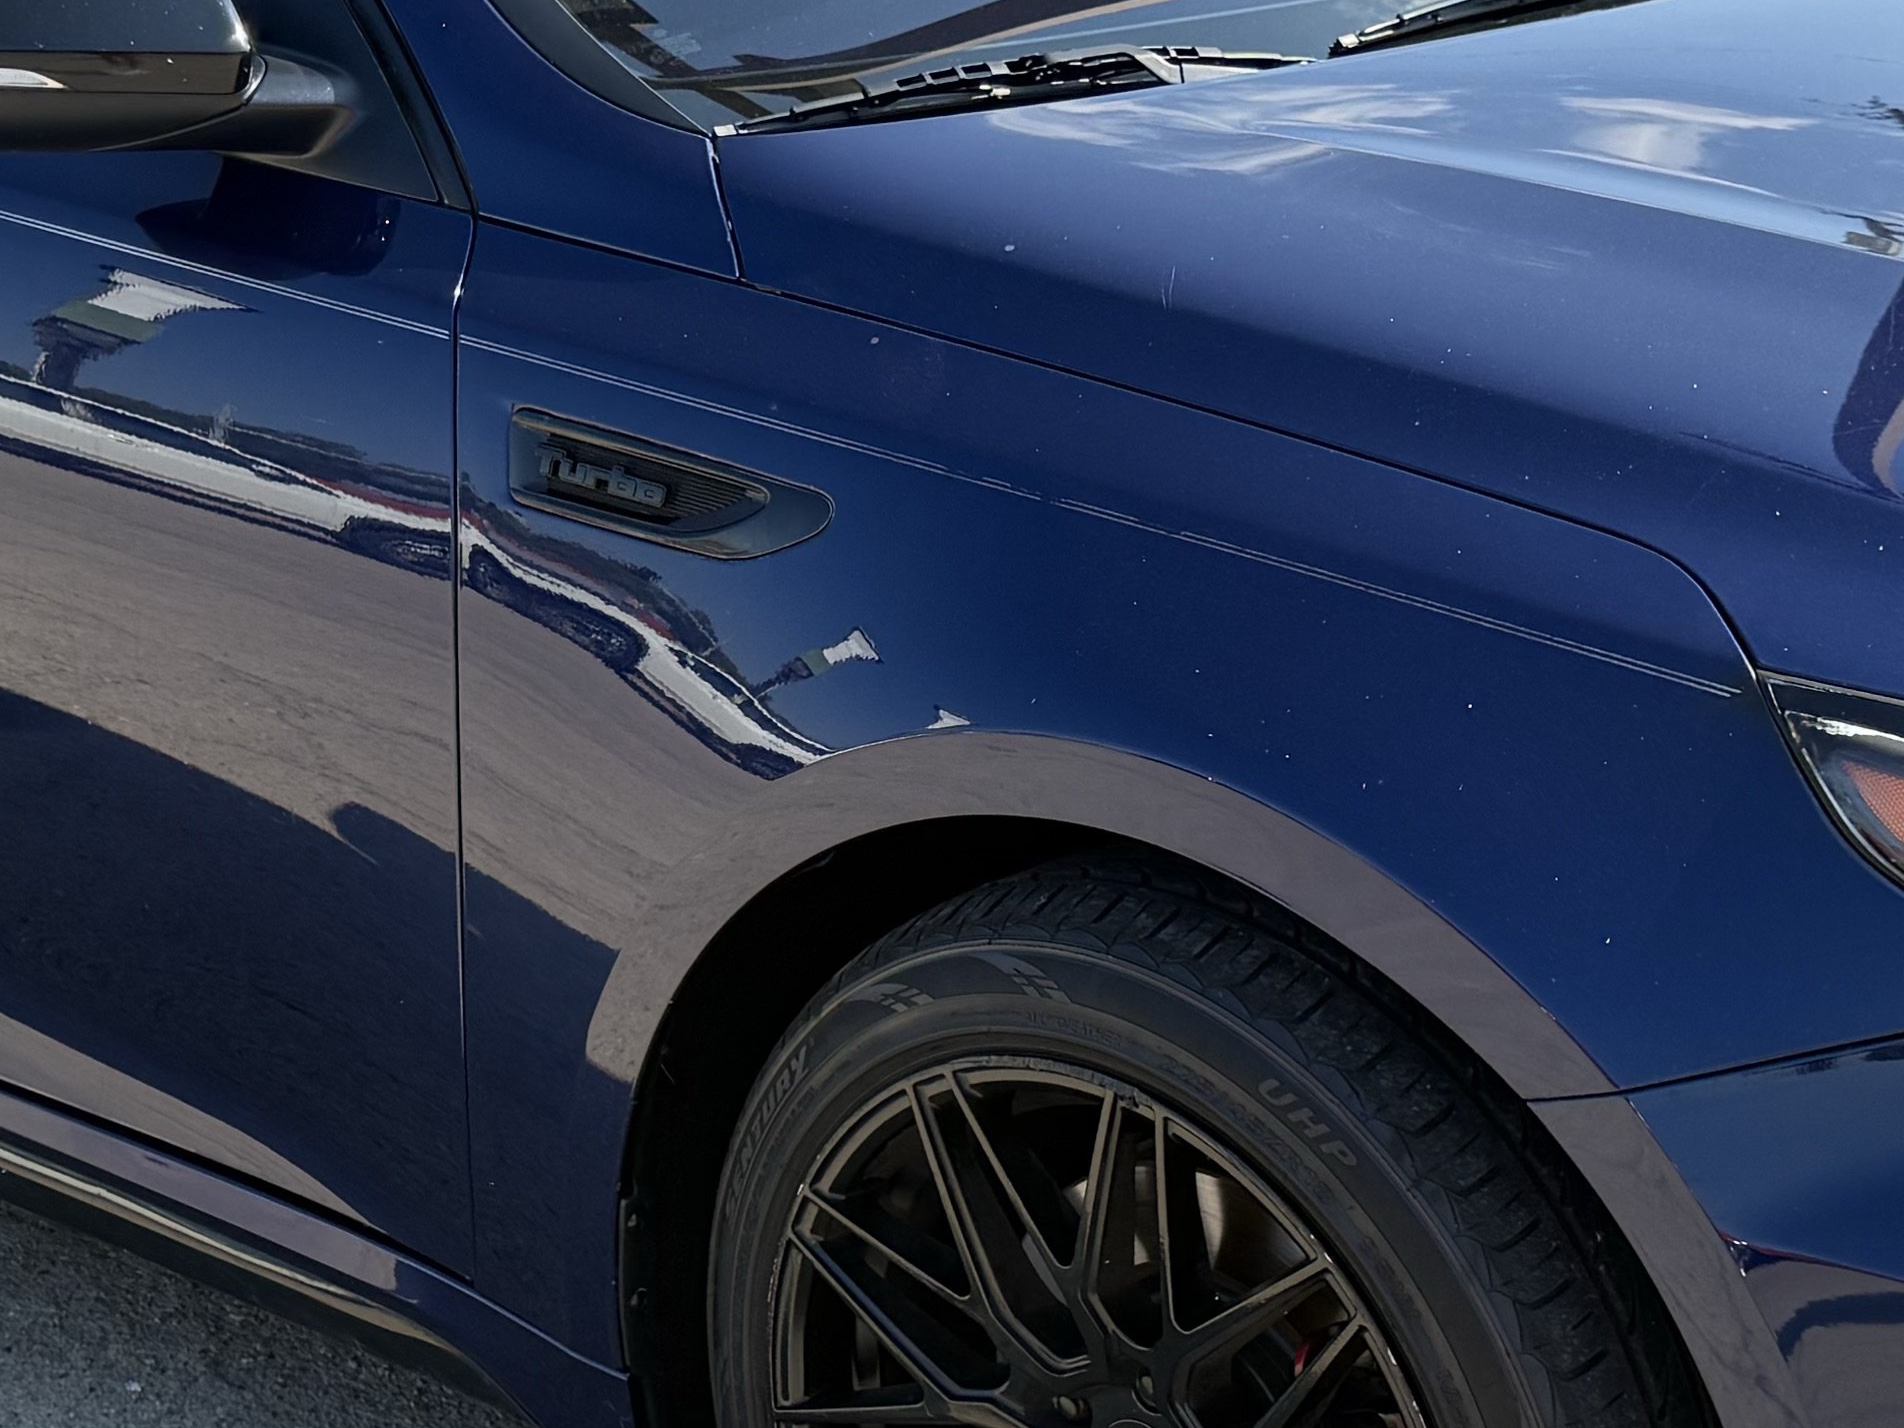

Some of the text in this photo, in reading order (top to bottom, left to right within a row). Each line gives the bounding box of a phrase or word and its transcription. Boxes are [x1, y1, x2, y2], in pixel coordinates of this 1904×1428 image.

[537, 443, 667, 509] Turbo
[725, 1044, 809, 1220] SENTURY
[1257, 1078, 1359, 1168] UHP
